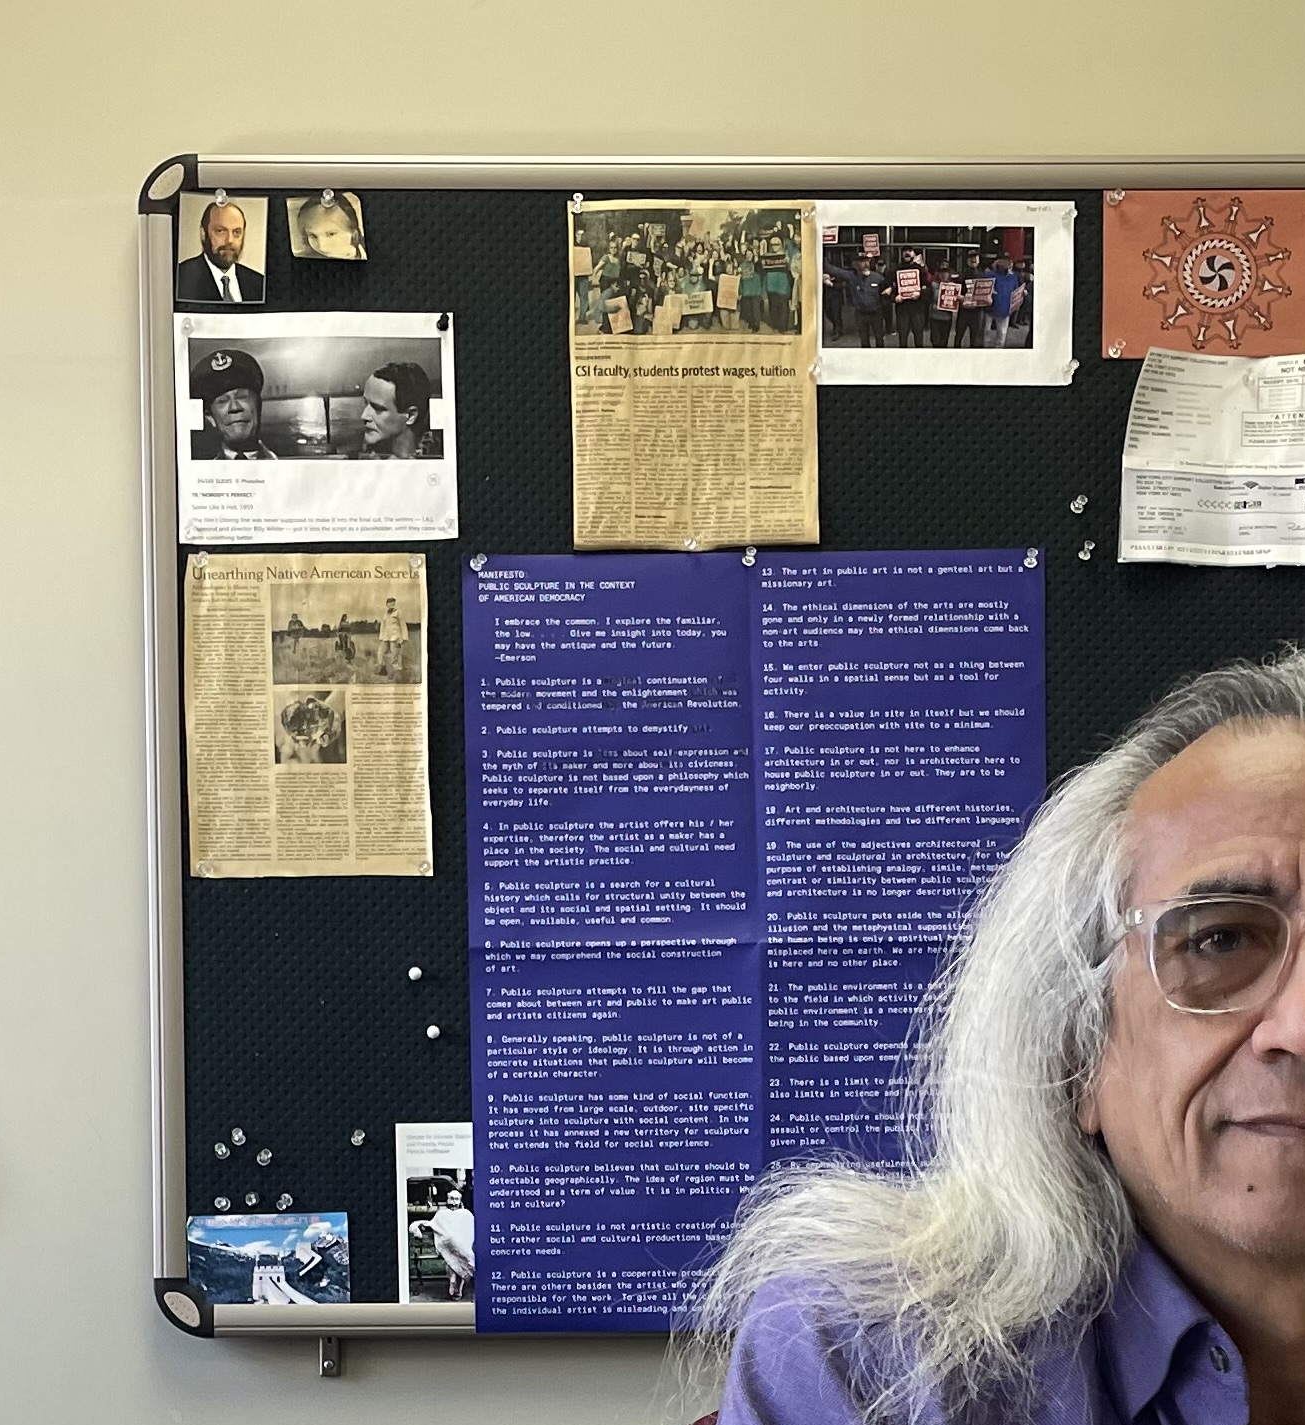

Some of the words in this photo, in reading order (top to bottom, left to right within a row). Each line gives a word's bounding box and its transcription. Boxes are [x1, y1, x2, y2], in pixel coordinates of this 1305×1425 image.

[575, 365, 591, 377] CSI
[593, 364, 632, 379] faculty,
[633, 364, 680, 377] students
[681, 365, 720, 379] protest
[722, 366, 758, 379] wages,
[760, 364, 796, 377] tuition
[192, 566, 264, 583] Unearthing
[266, 566, 308, 581] Native
[309, 565, 372, 580] American
[373, 565, 420, 580] Secrets
[782, 567, 798, 576] The
[802, 567, 818, 576] art
[822, 567, 832, 575] in
[836, 567, 868, 576] public
[872, 566, 888, 575] art
[892, 566, 902, 575] is
[908, 565, 922, 574] not
[938, 565, 974, 574] genteel
[978, 565, 994, 573] art
[998, 565, 1014, 573] but
[478, 582, 510, 591] PUBLIC
[514, 582, 560, 590] SCULPTURE
[564, 582, 576, 590] IN
[580, 581, 594, 590] THE
[600, 581, 636, 589] CONTEXT
[762, 580, 812, 588] missionary
[478, 594, 490, 602] OF
[494, 594, 536, 602] AMERICAN
[538, 594, 586, 602] DEMOCRACY
[494, 643, 510, 651] may
[514, 641, 536, 650] have
[540, 641, 556, 650] the
[560, 642, 596, 650] antique
[600, 641, 616, 649] and
[622, 641, 636, 649] the
[784, 805, 800, 814] Art
[806, 805, 822, 814] and
[826, 805, 886, 814] architecture
[890, 805, 910, 813] have
[914, 804, 960, 813] different
[764, 818, 810, 826] different
[814, 817, 880, 826] methodologies
[886, 816, 900, 825] and
[906, 817, 922, 825] two
[924, 816, 970, 824] different
[484, 894, 520, 903] history
[524, 893, 550, 902] which
[554, 893, 580, 901] calls
[586, 892, 600, 901] for
[604, 892, 656, 900] structural
[660, 892, 686, 900] unity
[690, 891, 726, 900] between
[730, 890, 746, 899] the
[486, 1001, 512, 1009] comes
[516, 999, 542, 1008] about
[546, 999, 582, 1008] between
[586, 999, 602, 1007] art
[606, 998, 622, 1007] and
[626, 998, 658, 1007] public
[662, 998, 672, 1006] to
[676, 997, 698, 1006] make
[702, 997, 718, 1005] art
[722, 996, 752, 1005] public
[486, 1012, 502, 1020] and
[506, 1011, 542, 1020] artists
[546, 1011, 586, 1019] citizens
[768, 1020, 794, 1028] being
[798, 1019, 808, 1028] in
[814, 1019, 828, 1027] the
[508, 1164, 540, 1173] Public
[544, 1164, 590, 1173] sculpture
[594, 1163, 634, 1172] believes
[640, 1163, 660, 1172] that
[664, 1163, 700, 1171] culture
[704, 1162, 734, 1170] should
[738, 1162, 750, 1170] be
[490, 1200, 504, 1209] not
[510, 1200, 520, 1209] in
[524, 1199, 566, 1208] culture?
